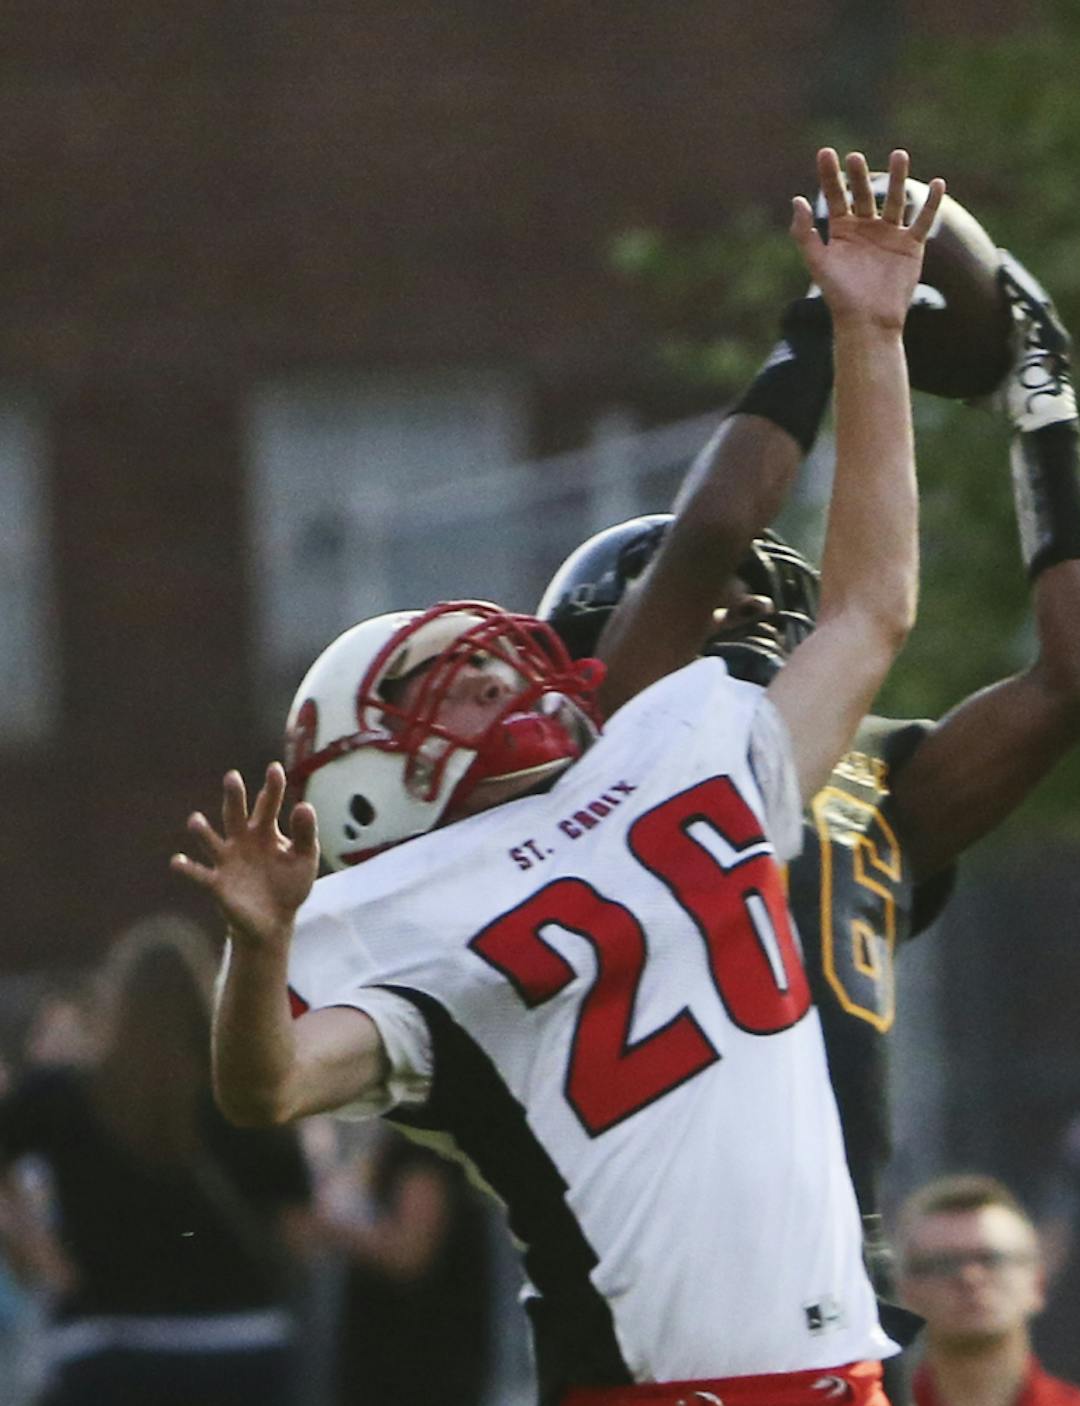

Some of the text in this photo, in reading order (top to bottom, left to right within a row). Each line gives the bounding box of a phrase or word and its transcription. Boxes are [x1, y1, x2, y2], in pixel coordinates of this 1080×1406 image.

[509, 781, 638, 871] ST. CROIX
[812, 786, 901, 1034] 6
[467, 774, 812, 1140] 26
